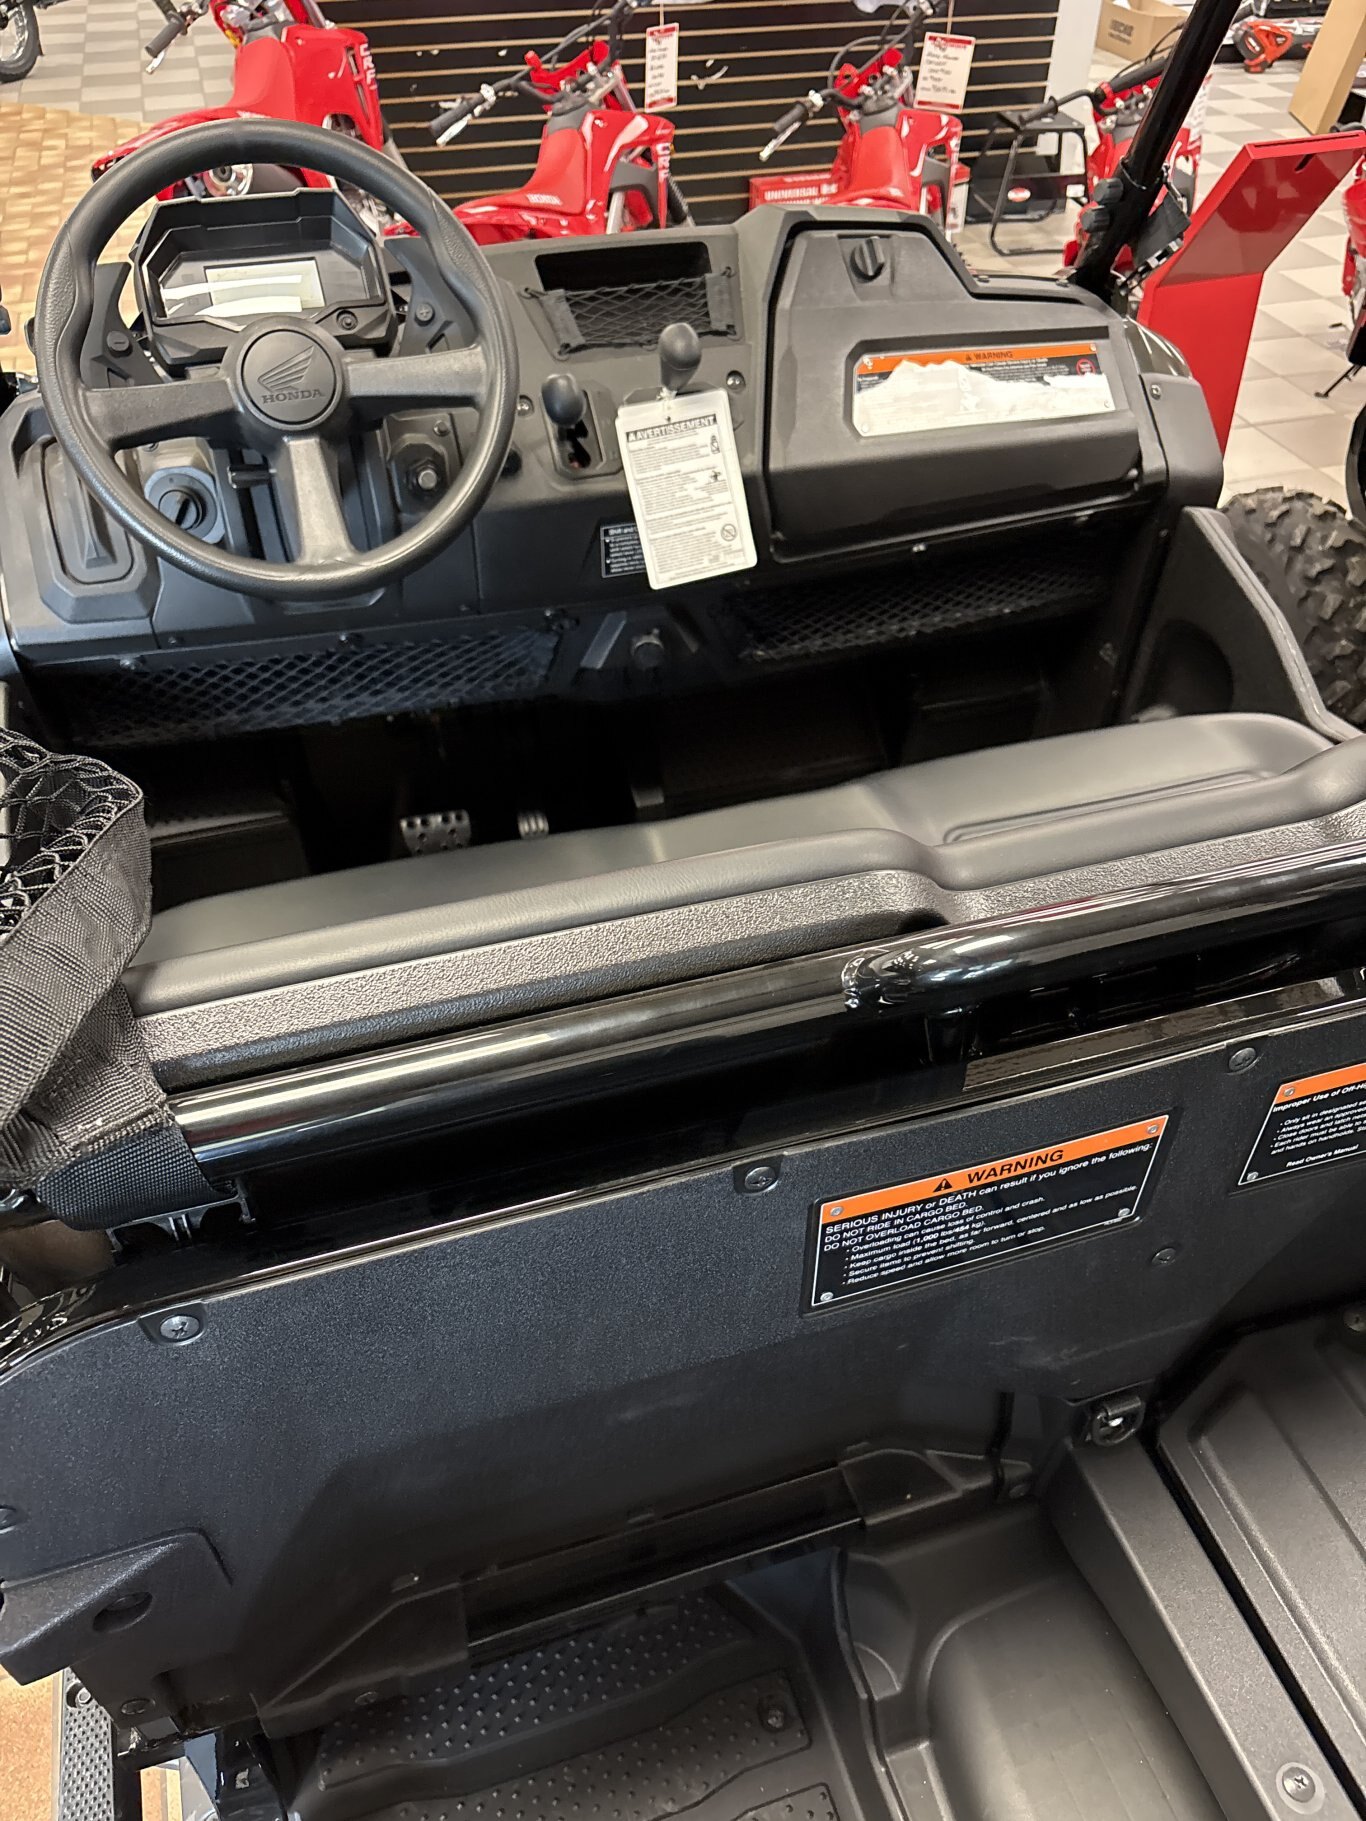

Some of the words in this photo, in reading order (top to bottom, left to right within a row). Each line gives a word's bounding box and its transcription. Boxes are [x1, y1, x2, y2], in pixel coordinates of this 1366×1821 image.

[360, 43, 376, 85] CRF
[974, 351, 1013, 360] WARNING
[262, 389, 323, 404] HONDA
[636, 416, 714, 440] AVERTISSEMENT
[1273, 1097, 1310, 1113] Improper
[1313, 1092, 1329, 1101] Use
[966, 1149, 1065, 1184] WARNING
[1286, 1158, 1304, 1167] Read
[1305, 1151, 1331, 1162] Owner's
[1334, 1144, 1358, 1154] Manual
[825, 1214, 878, 1235] SERIOUS
[881, 1203, 923, 1220] INJURY
[939, 1189, 976, 1205] DEATH
[980, 1185, 998, 1195] can
[1000, 1176, 1028, 1189] result
[1037, 1170, 1057, 1181] you
[1058, 1160, 1089, 1175] ignore
[1090, 1155, 1107, 1164] the
[1108, 1142, 1153, 1161] following:
[824, 1234, 840, 1243] DO
[843, 1227, 864, 1238] NOT
[867, 1221, 891, 1232] RIDE
[906, 1207, 943, 1222] CARGO
[945, 1201, 968, 1212] BED.
[824, 1242, 839, 1251] DO
[842, 1236, 863, 1247] NOT
[865, 1220, 921, 1241] OVERLOAD
[923, 1211, 960, 1225] CARGO
[962, 1204, 985, 1215] BED.
[849, 1258, 871, 1269] Keep
[873, 1252, 896, 1263] cargo
[898, 1245, 922, 1255] inside
[924, 1240, 937, 1248] the
[1016, 1209, 1051, 1223] centered
[1052, 1204, 1067, 1213] and
[1079, 1197, 1093, 1205] low
[1104, 1184, 1138, 1199] possible.
[851, 1234, 902, 1254] Overloading
[904, 1231, 919, 1239] can
[921, 1223, 946, 1234] cause
[948, 1218, 964, 1227] loss
[975, 1208, 1003, 1219] control
[1004, 1203, 1020, 1211] and
[1021, 1196, 1045, 1207] crash.
[847, 1271, 879, 1284] Reduce
[880, 1264, 905, 1276] speed
[907, 1259, 922, 1268] and
[928, 1253, 945, 1262] allow
[947, 1248, 966, 1257] more
[969, 1242, 989, 1250] room
[1000, 1234, 1016, 1242] turn
[1026, 1225, 1045, 1235] stop.
[848, 1264, 878, 1277] Secure
[879, 1258, 901, 1268] items
[913, 1247, 943, 1260] prevent
[945, 1238, 975, 1251] shifting.
[850, 1245, 891, 1261] Maximum
[893, 1240, 910, 1249] load
[913, 1232, 939, 1244] (1,000
